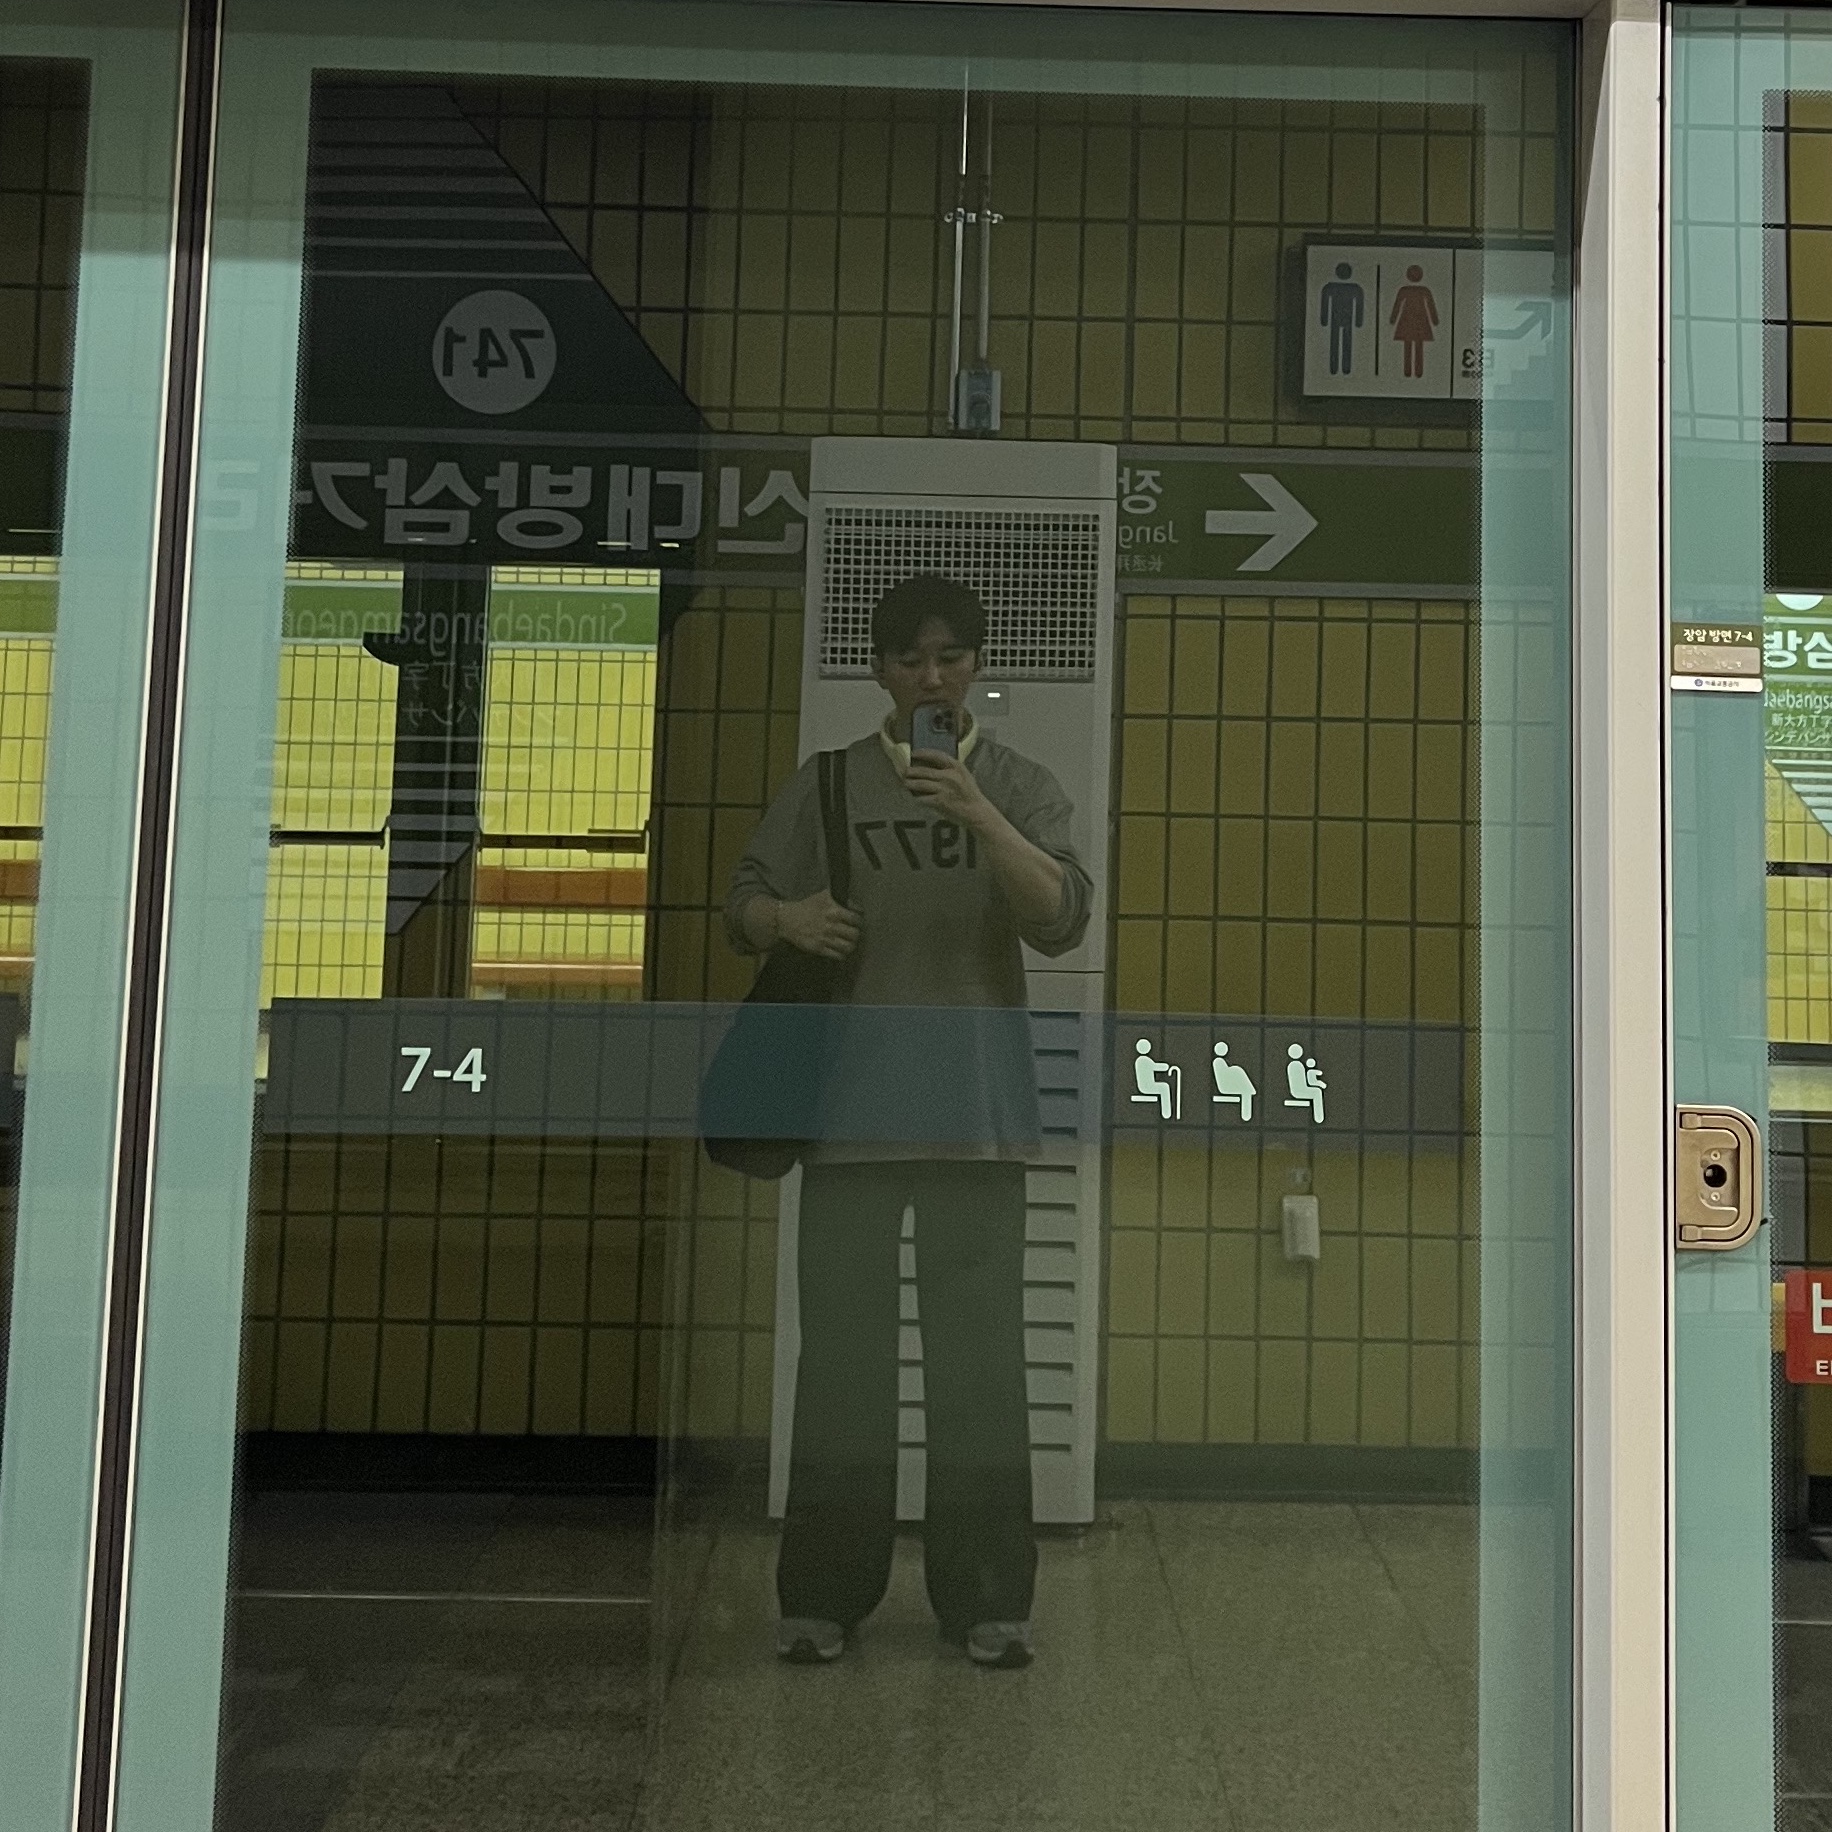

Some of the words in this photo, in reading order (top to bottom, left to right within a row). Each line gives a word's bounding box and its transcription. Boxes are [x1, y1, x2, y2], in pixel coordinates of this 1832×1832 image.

[1683, 628, 1707, 643] 장암
[1708, 629, 1733, 644] 방면
[1734, 630, 1753, 642] 7-4
[401, 1046, 487, 1093] 7-4
